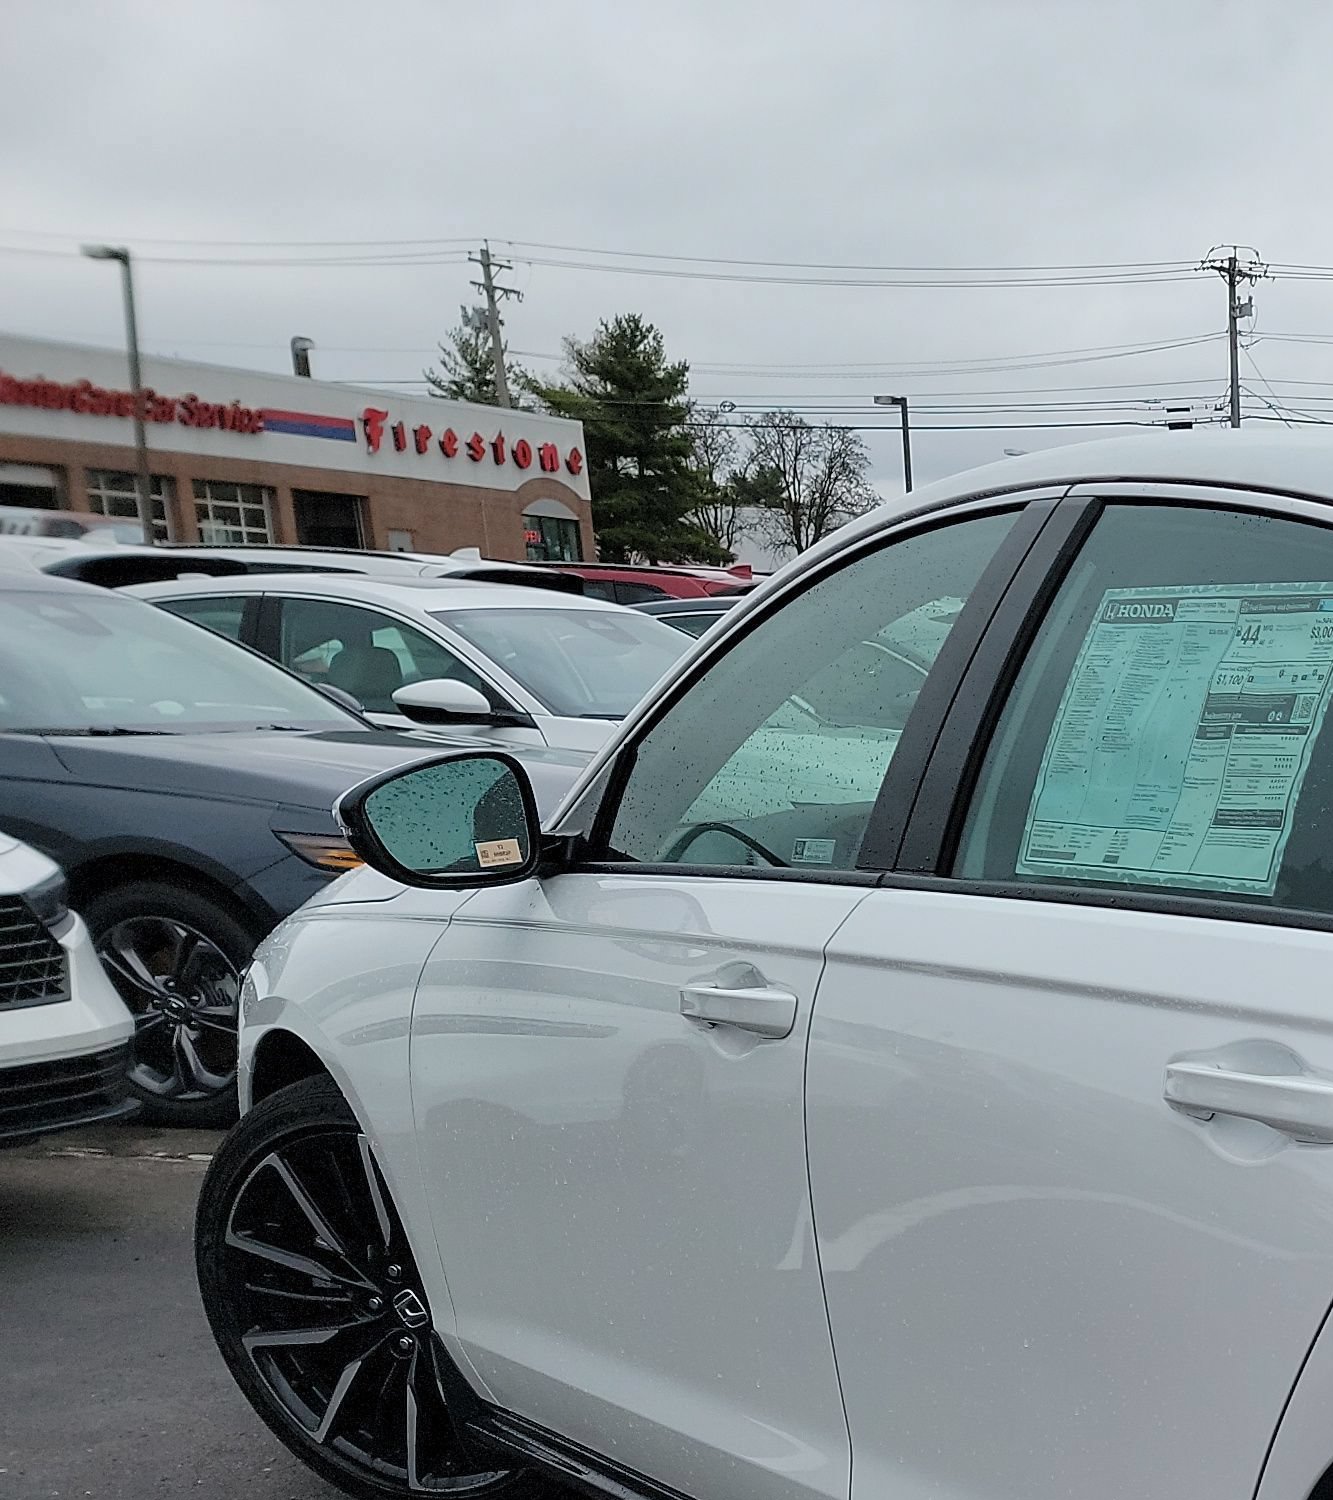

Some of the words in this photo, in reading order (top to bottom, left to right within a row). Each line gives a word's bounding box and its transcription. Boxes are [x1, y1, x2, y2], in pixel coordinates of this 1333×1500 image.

[359, 407, 584, 476] Firestone
[1116, 604, 1174, 618] HONDA
[1240, 625, 1261, 645] 44
[1216, 674, 1244, 686] $1,100
